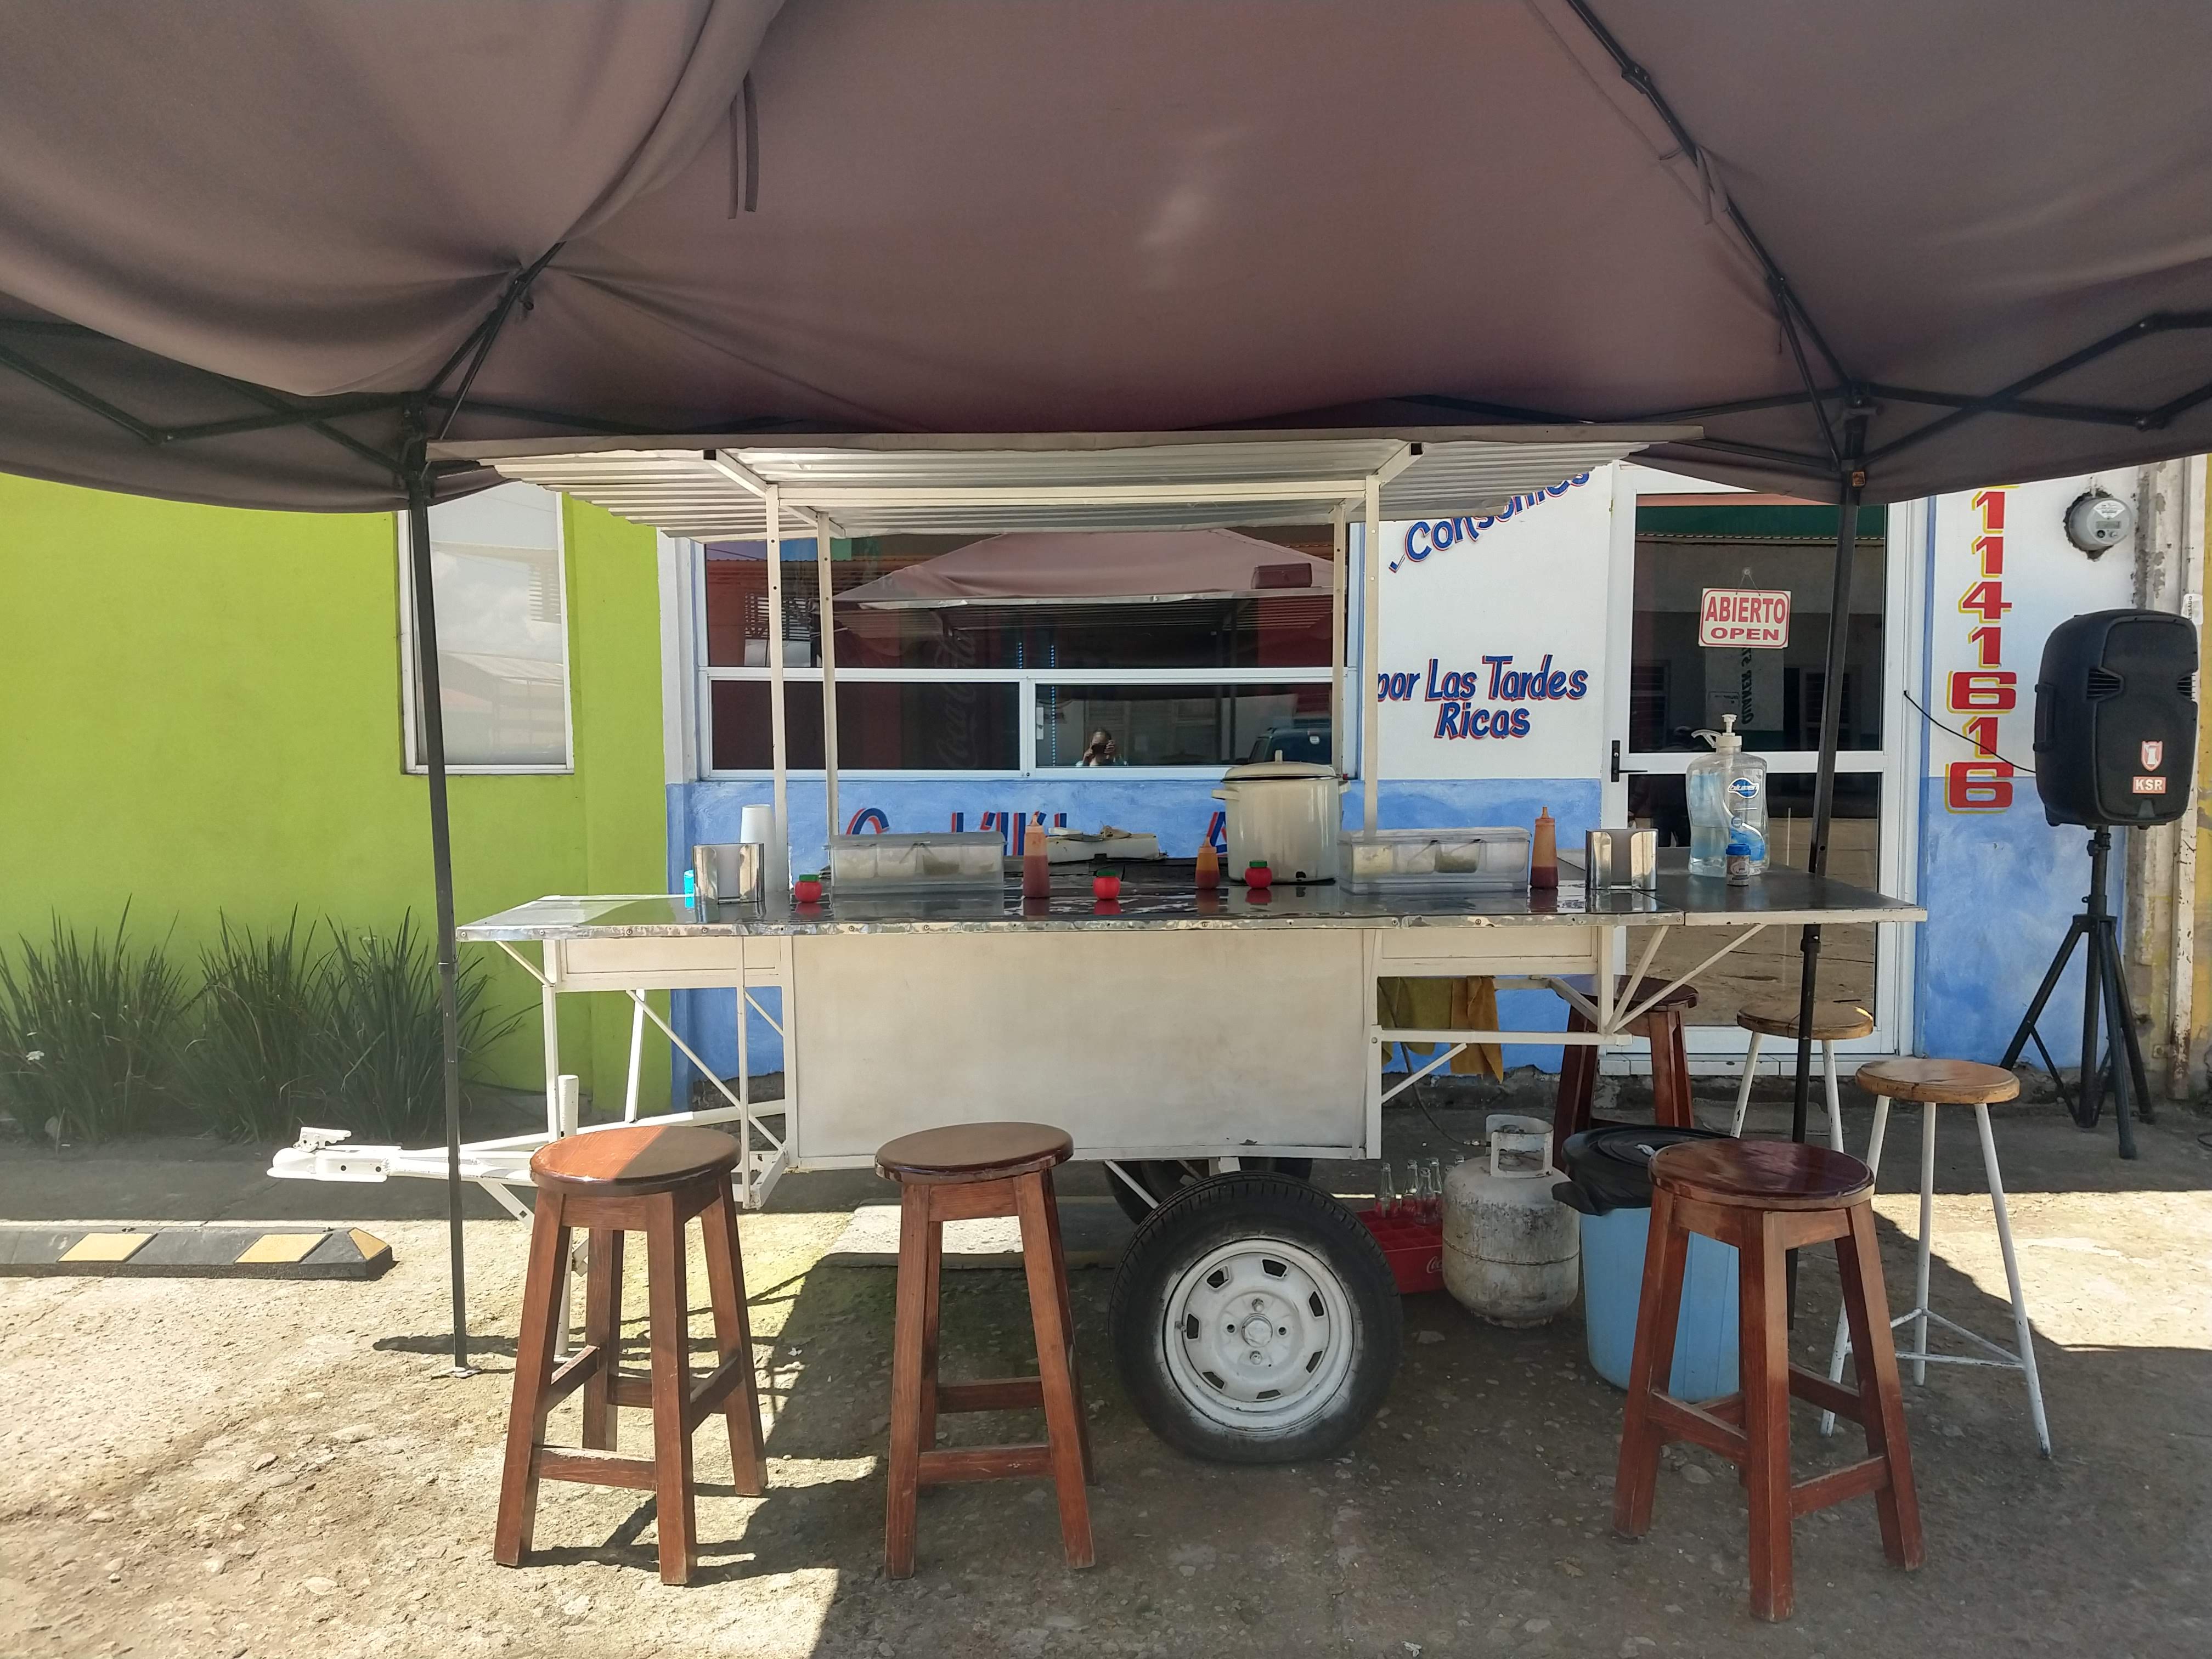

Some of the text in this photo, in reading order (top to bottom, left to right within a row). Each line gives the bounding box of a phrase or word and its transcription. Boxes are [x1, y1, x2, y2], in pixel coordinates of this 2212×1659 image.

[1705, 596, 1786, 624] ABIERTO
[1710, 627, 1780, 641] OPEN
[1945, 485, 2018, 815] 1141616
[1425, 659, 1479, 702] Las
[1481, 654, 1589, 701] Tardes
[1434, 702, 1531, 741] Ricas
[2134, 779, 2164, 792] KSR
